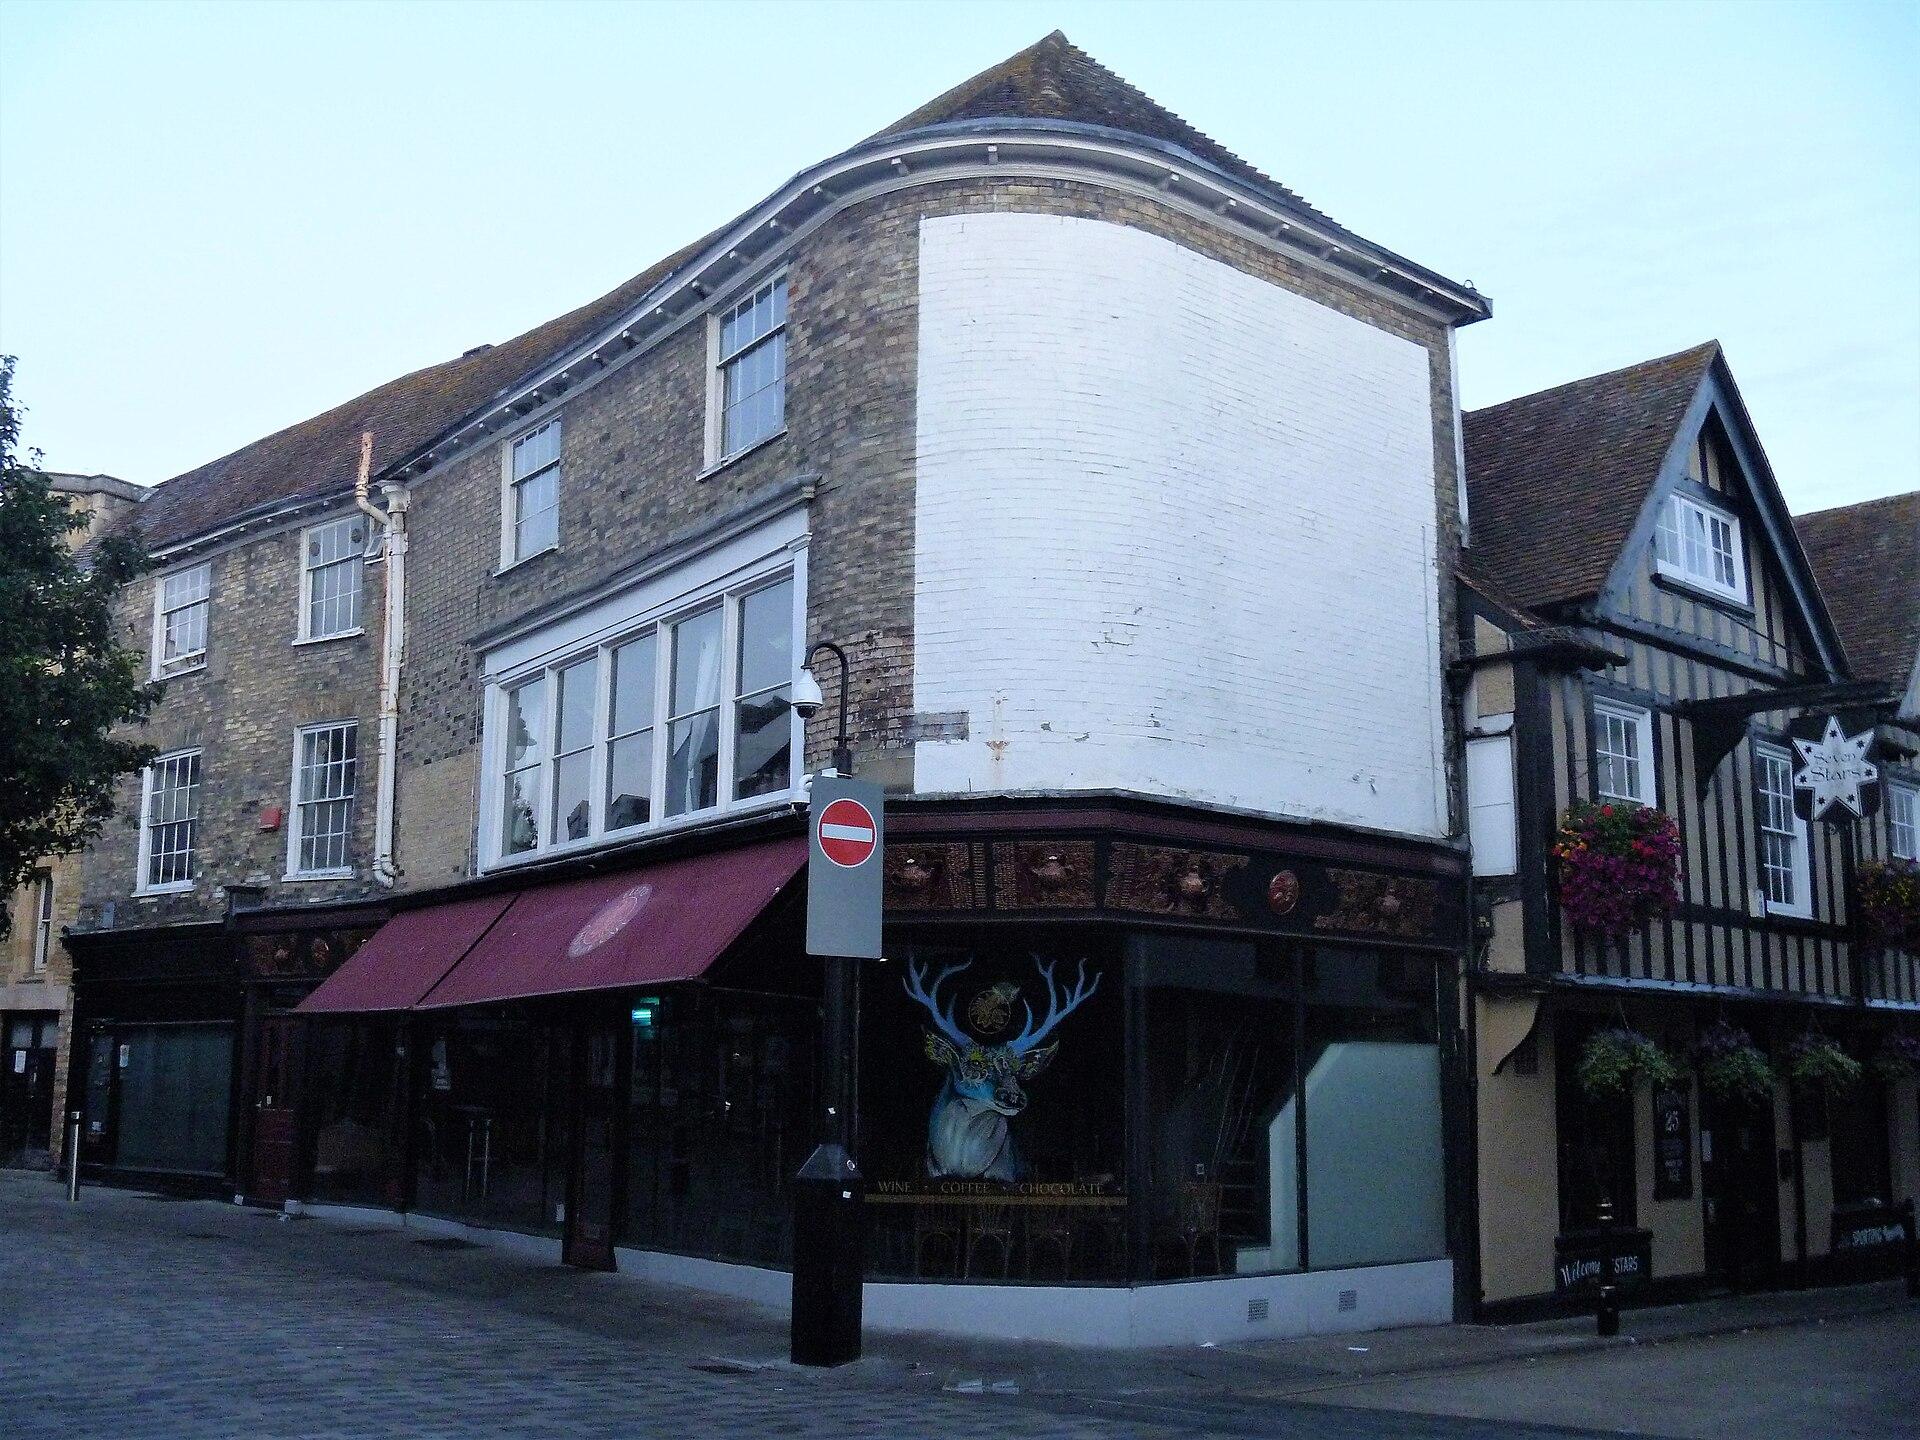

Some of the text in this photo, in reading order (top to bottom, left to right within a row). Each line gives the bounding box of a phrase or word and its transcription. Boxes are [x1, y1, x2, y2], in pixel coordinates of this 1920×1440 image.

[1811, 766, 1862, 782] Stars
[877, 1181, 1104, 1196] WINE COFFEE CHOCOLATE
